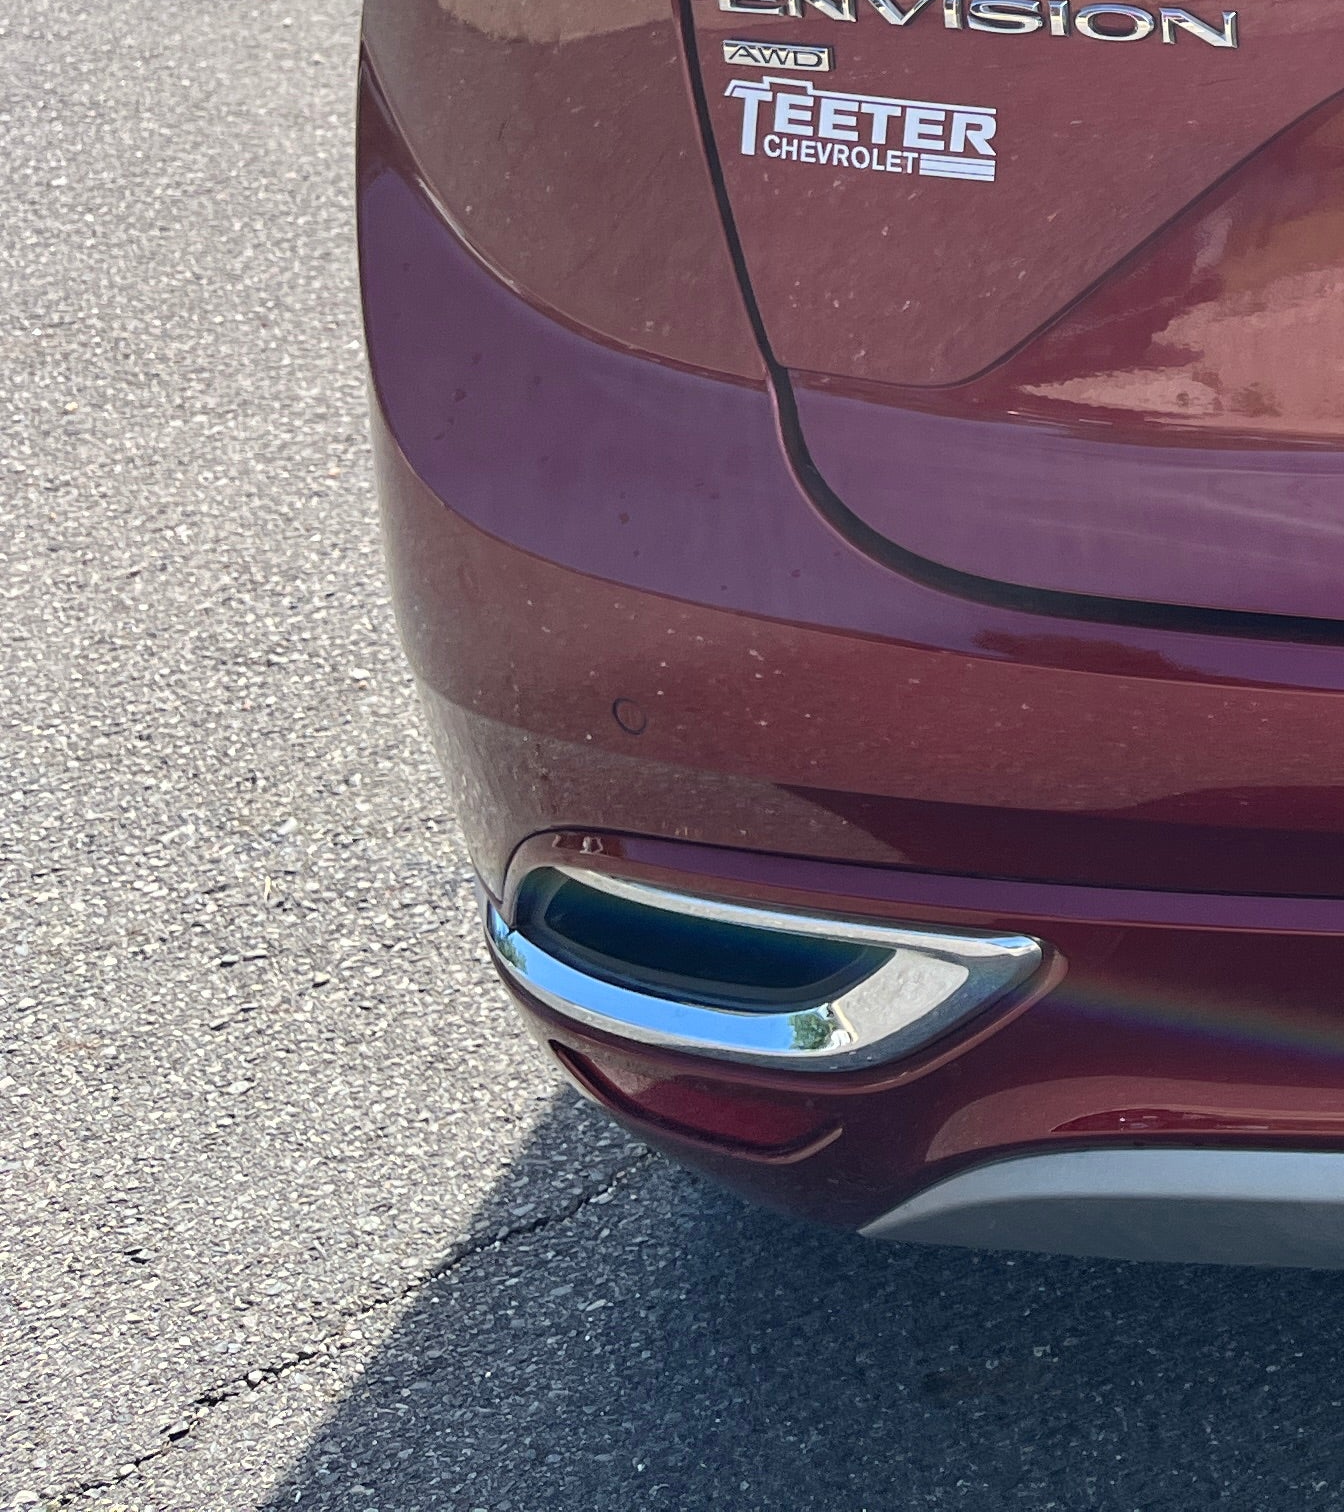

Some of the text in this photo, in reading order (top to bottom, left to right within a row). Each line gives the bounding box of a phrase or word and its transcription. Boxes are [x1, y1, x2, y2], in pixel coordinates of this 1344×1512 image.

[728, 44, 823, 68] AWD
[727, 88, 997, 156] TEETER
[762, 134, 919, 175] CHEVROLET
